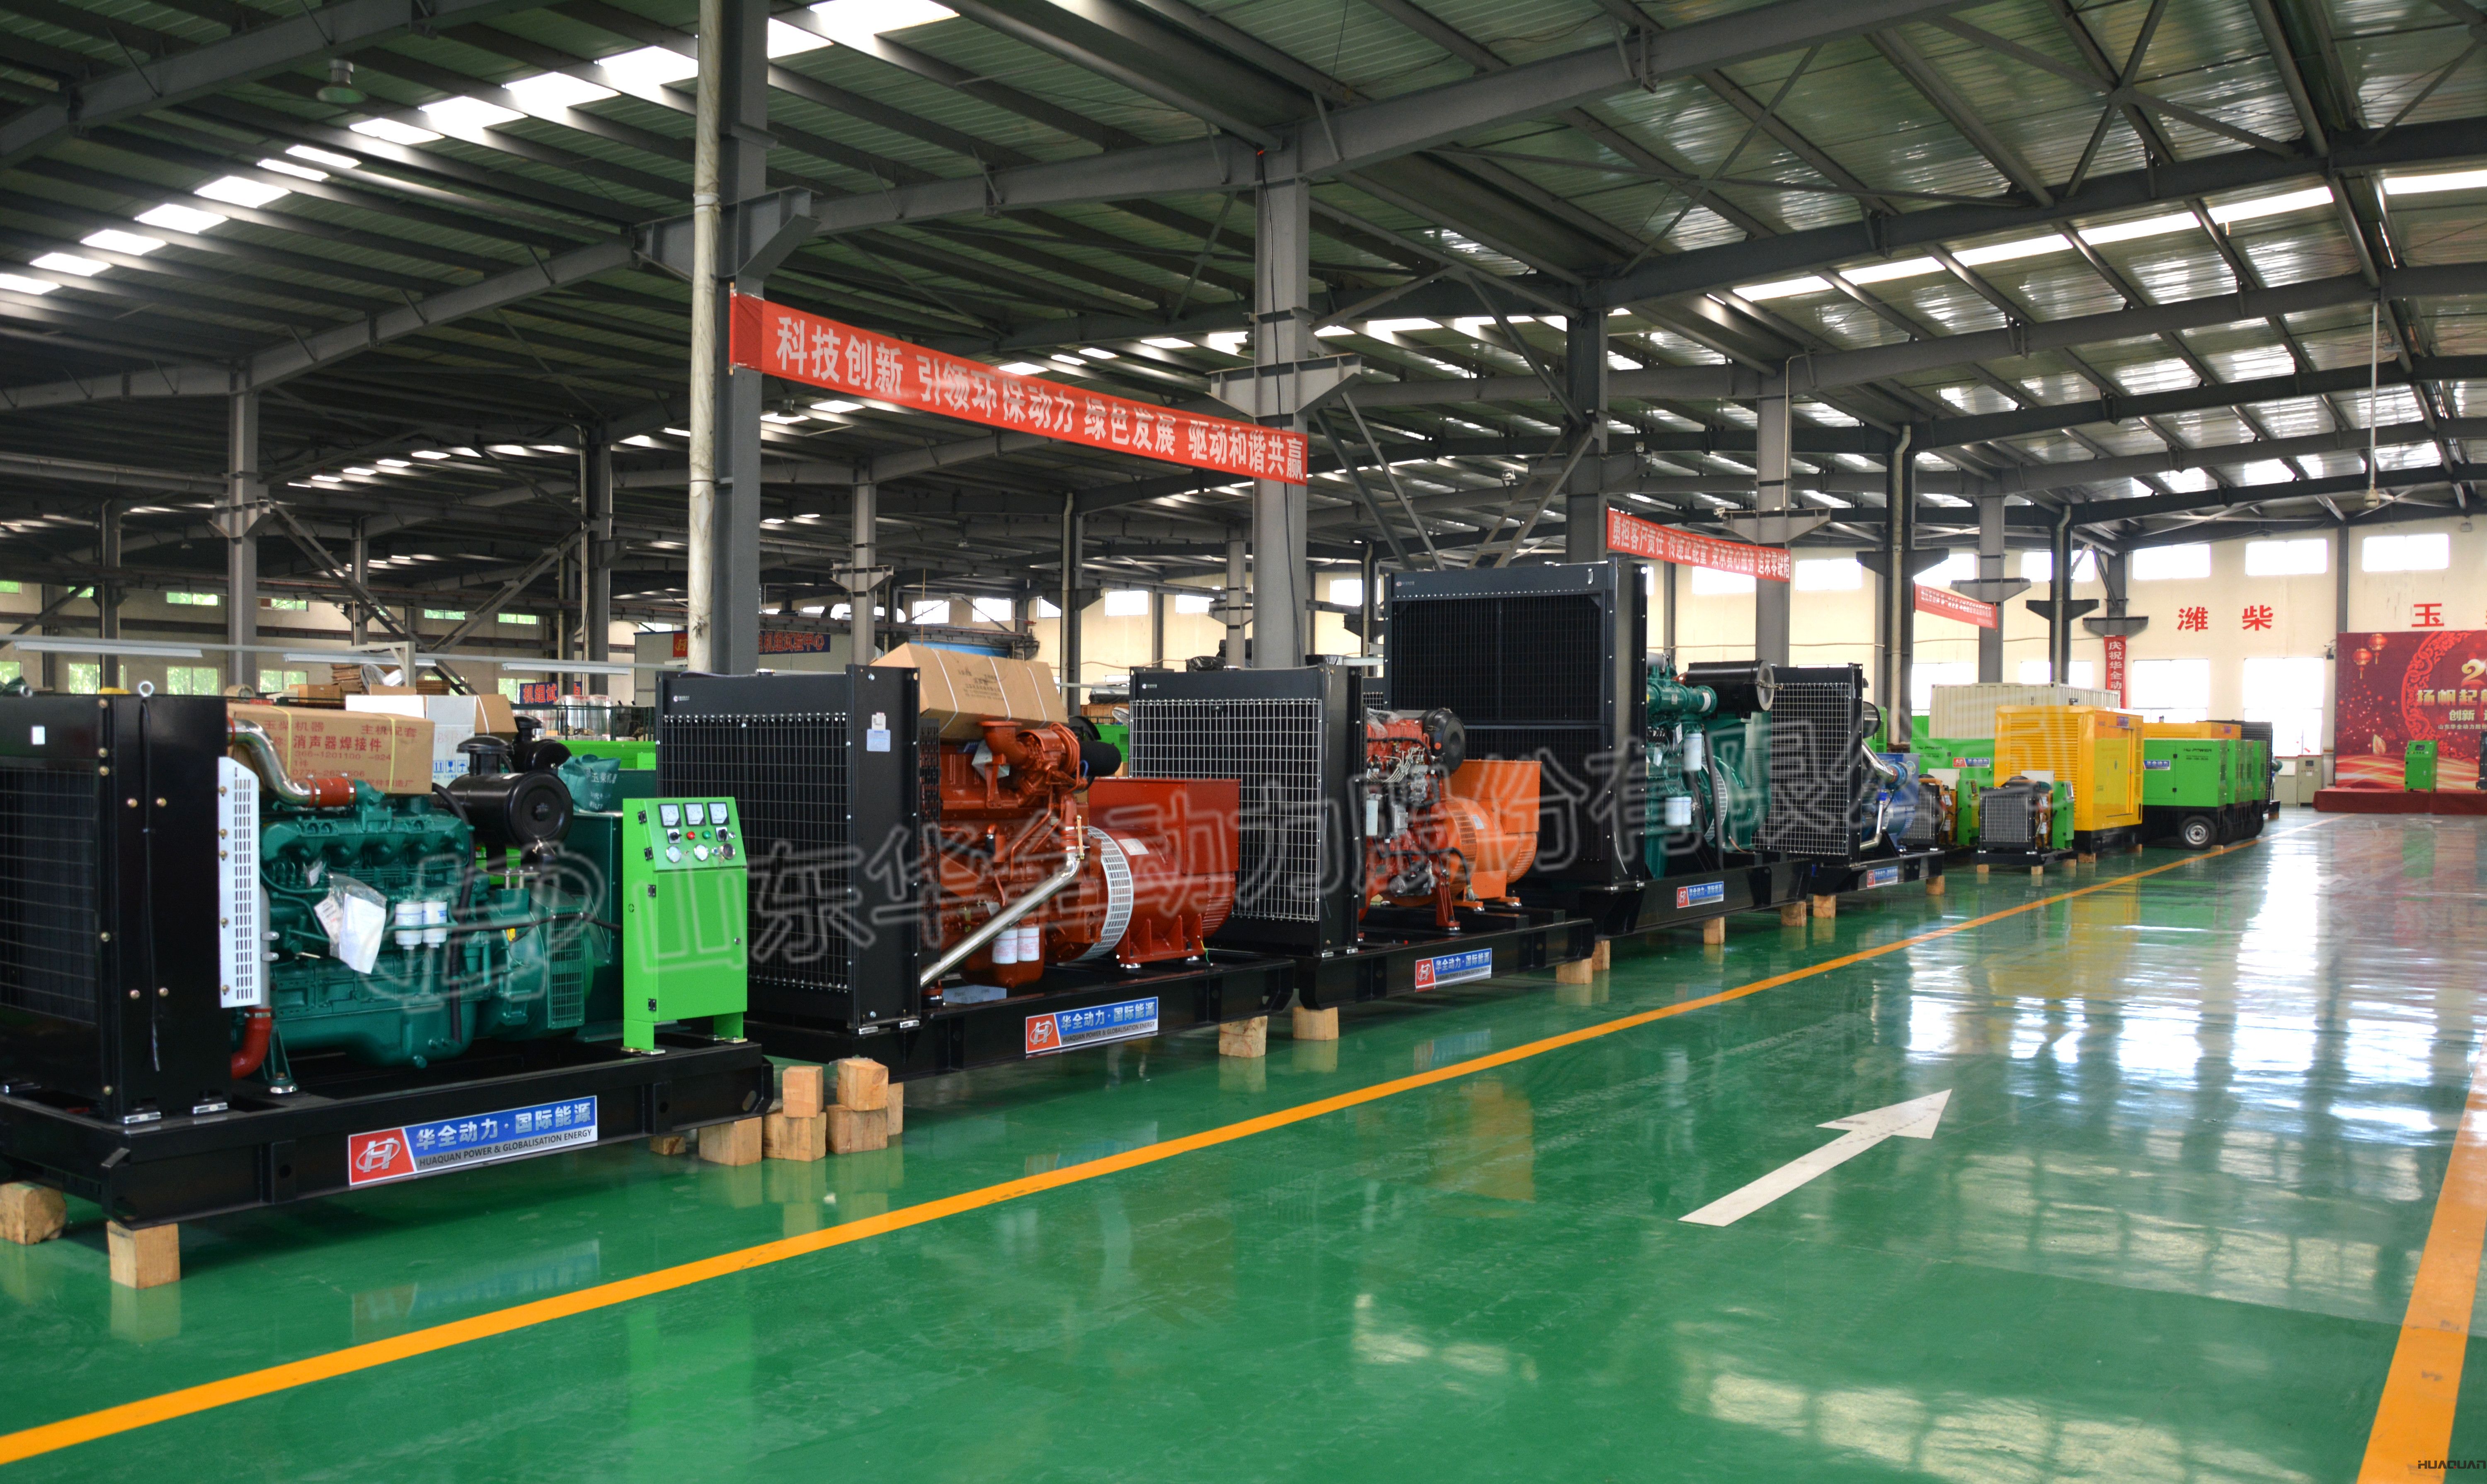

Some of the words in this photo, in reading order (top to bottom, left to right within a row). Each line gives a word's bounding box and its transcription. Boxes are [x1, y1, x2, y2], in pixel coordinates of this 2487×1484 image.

[777, 317, 903, 397] 科技创新
[916, 355, 1075, 432] 引领环保动力
[1084, 396, 1176, 456] 绿色发展
[1188, 419, 1303, 480] 驱动和谐共赢
[2461, 658, 2487, 687] 2
[2449, 709, 2475, 721] 创新
[293, 735, 382, 752] 消声器焊接件
[1062, 1033, 1085, 1043] HUAQUAN
[1086, 1031, 1101, 1040] POWER
[1107, 1025, 1139, 1037] GLOBALISATION
[416, 1102, 591, 1151] 华全动力·国际能源
[419, 1152, 461, 1167] HUAQUAN
[463, 1147, 492, 1159] POWER
[503, 1134, 562, 1152] GLOBALISATION
[564, 1128, 593, 1142] ENERGY
